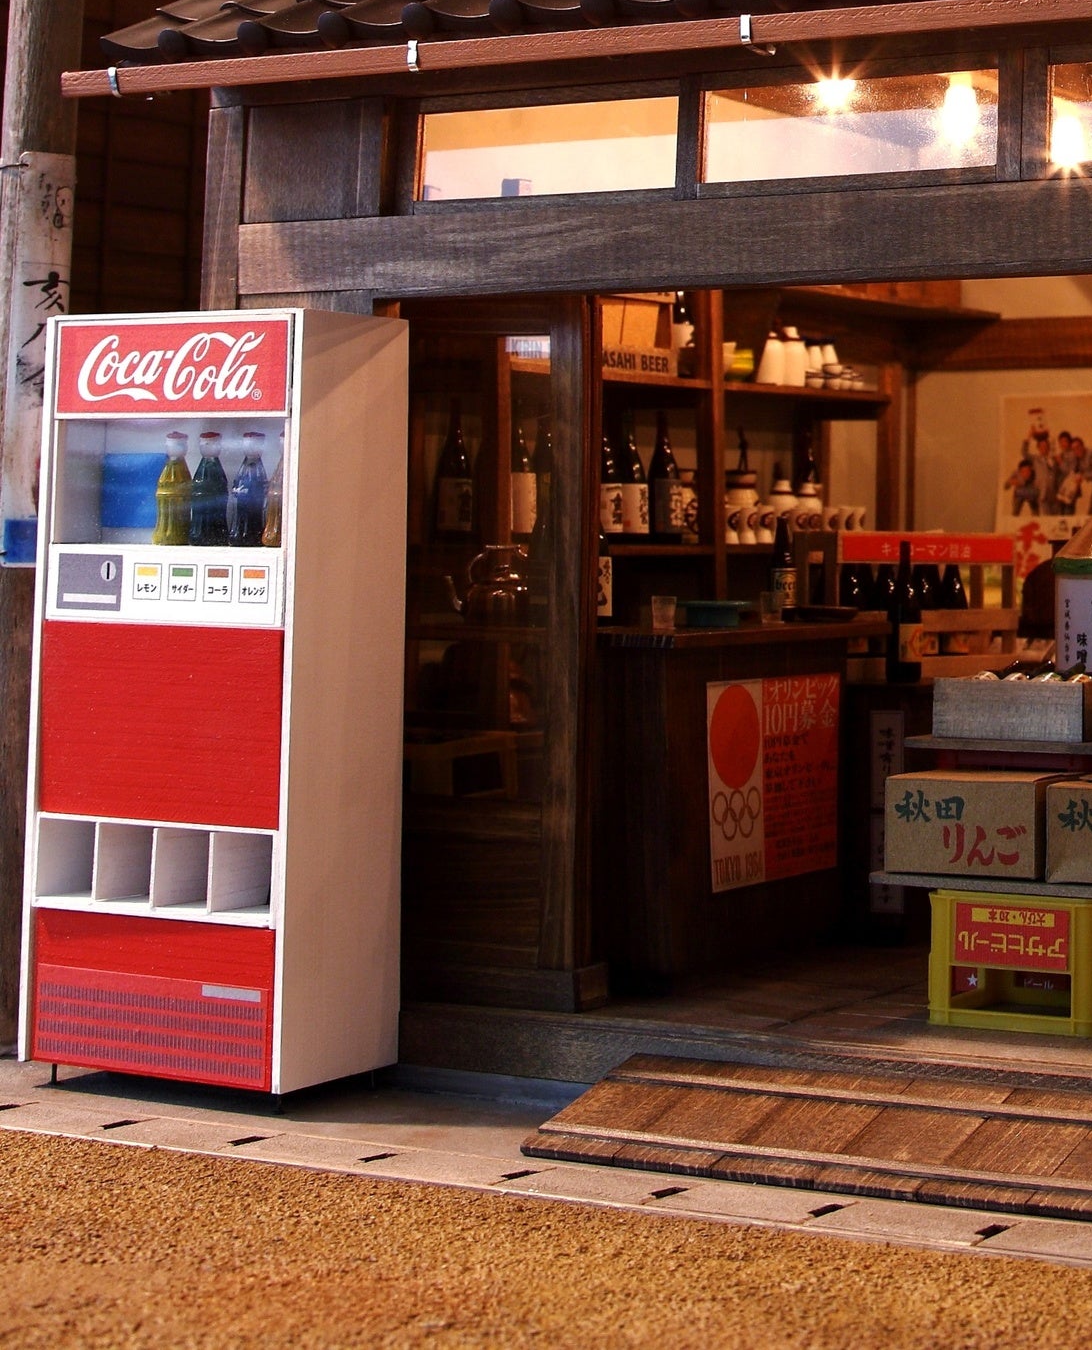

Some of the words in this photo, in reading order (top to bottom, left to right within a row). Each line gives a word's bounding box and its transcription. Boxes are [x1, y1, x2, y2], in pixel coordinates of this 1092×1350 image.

[77, 331, 266, 401] Coca-Cola
[602, 349, 637, 371] ASAHI
[641, 352, 669, 374] BEER
[881, 542, 972, 559] キーマン醤油
[137, 584, 158, 594] レモン
[172, 585, 194, 594] サイダー
[208, 586, 228, 595] コーラ
[242, 587, 266, 596] オレンジ
[764, 699, 836, 735] 10円募金
[895, 790, 965, 823] 秋田
[942, 823, 1027, 867] りんご
[713, 854, 740, 886] TOKYO
[958, 930, 1066, 958] アサヒビール
